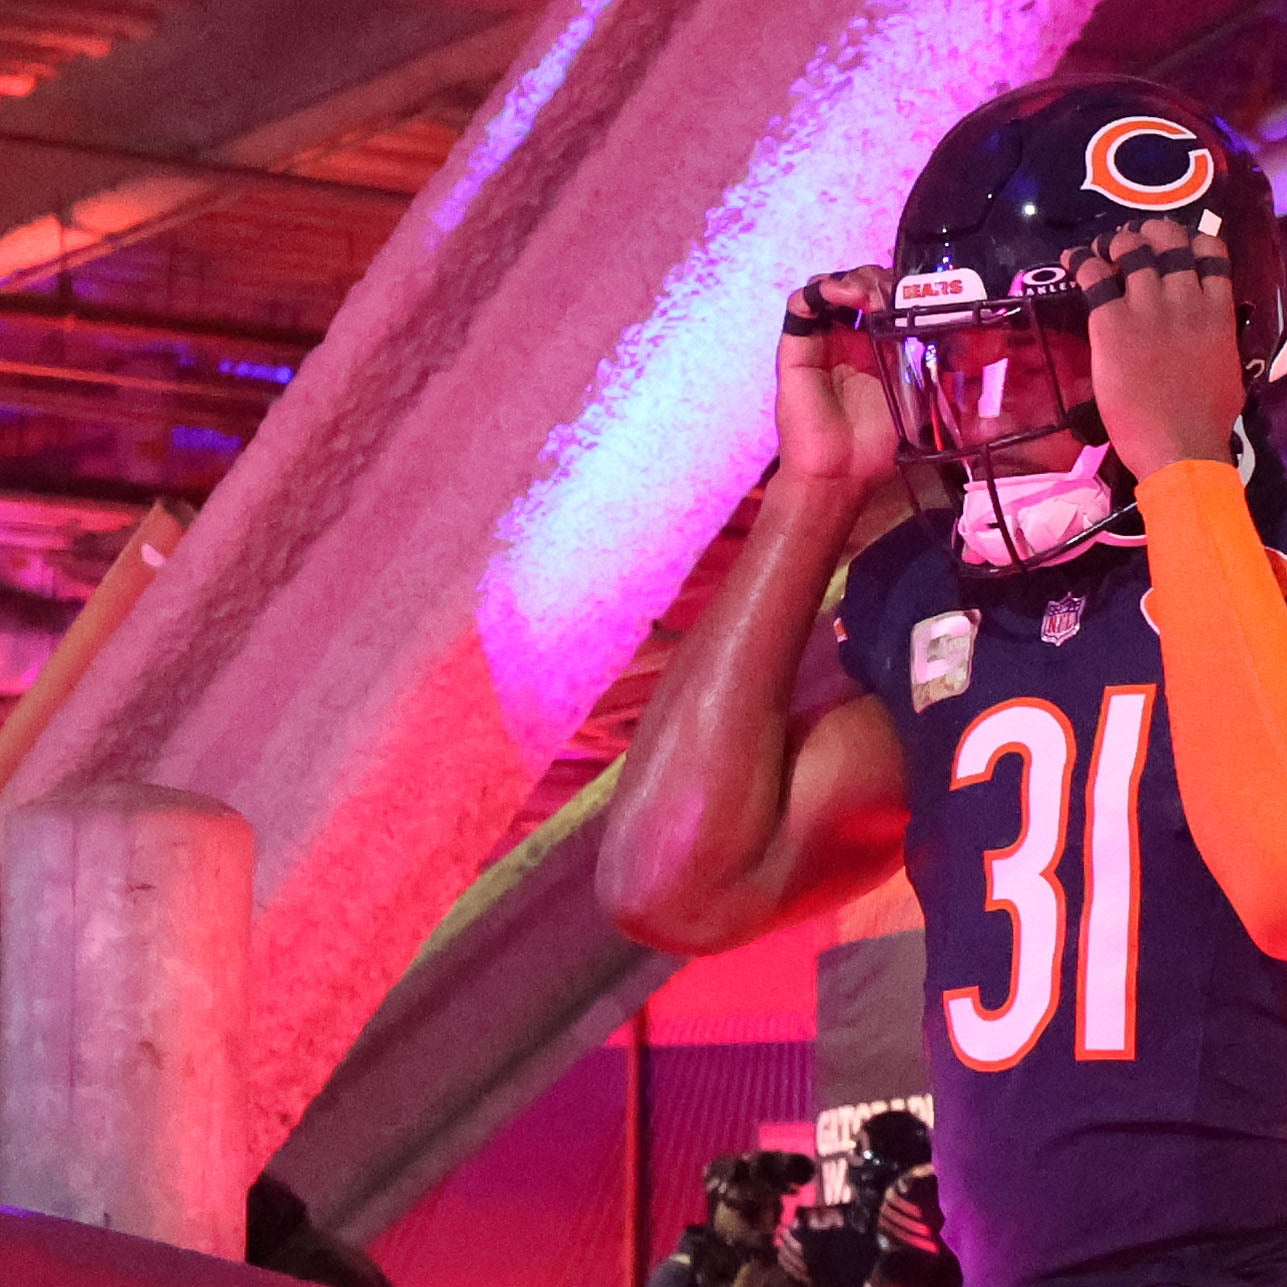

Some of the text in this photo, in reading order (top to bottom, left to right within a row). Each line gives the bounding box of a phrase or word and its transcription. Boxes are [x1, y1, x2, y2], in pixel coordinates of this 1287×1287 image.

[1080, 115, 1215, 212] C
[902, 279, 963, 300] BEARS
[942, 684, 1158, 1073] 31
